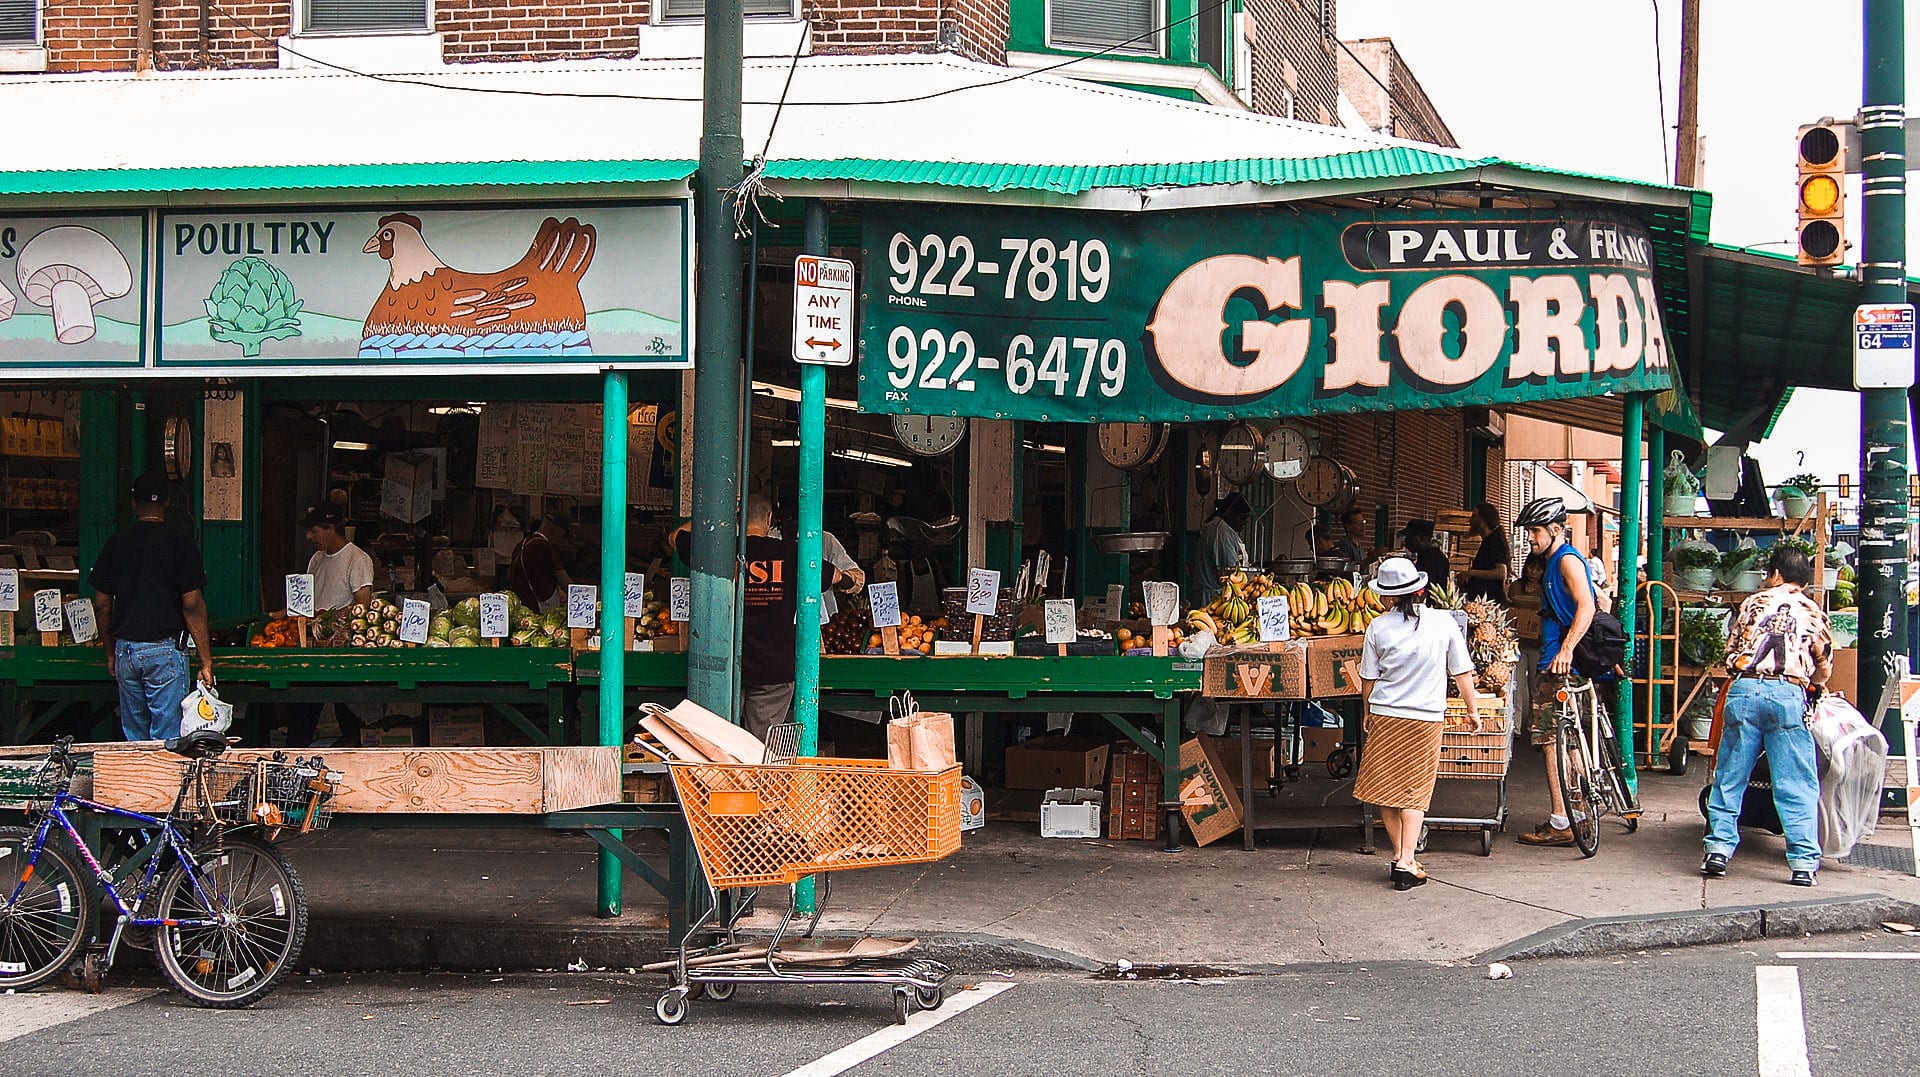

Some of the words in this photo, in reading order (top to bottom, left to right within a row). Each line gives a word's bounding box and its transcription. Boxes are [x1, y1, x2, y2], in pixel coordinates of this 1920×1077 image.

[175, 221, 335, 256] POULTRY
[1387, 229, 1532, 263] PAUL
[1547, 228, 1579, 260] &
[799, 261, 817, 283] NO
[820, 267, 850, 283] PARKING
[888, 232, 1110, 303] 922-7819
[808, 295, 840, 309] ANY
[888, 295, 928, 307] PHONE
[807, 315, 841, 330] TIME
[1877, 313, 1901, 321] SEPTA
[1861, 334, 1882, 349] 64
[887, 325, 1127, 398] 922-6479
[885, 391, 909, 401] FAX
